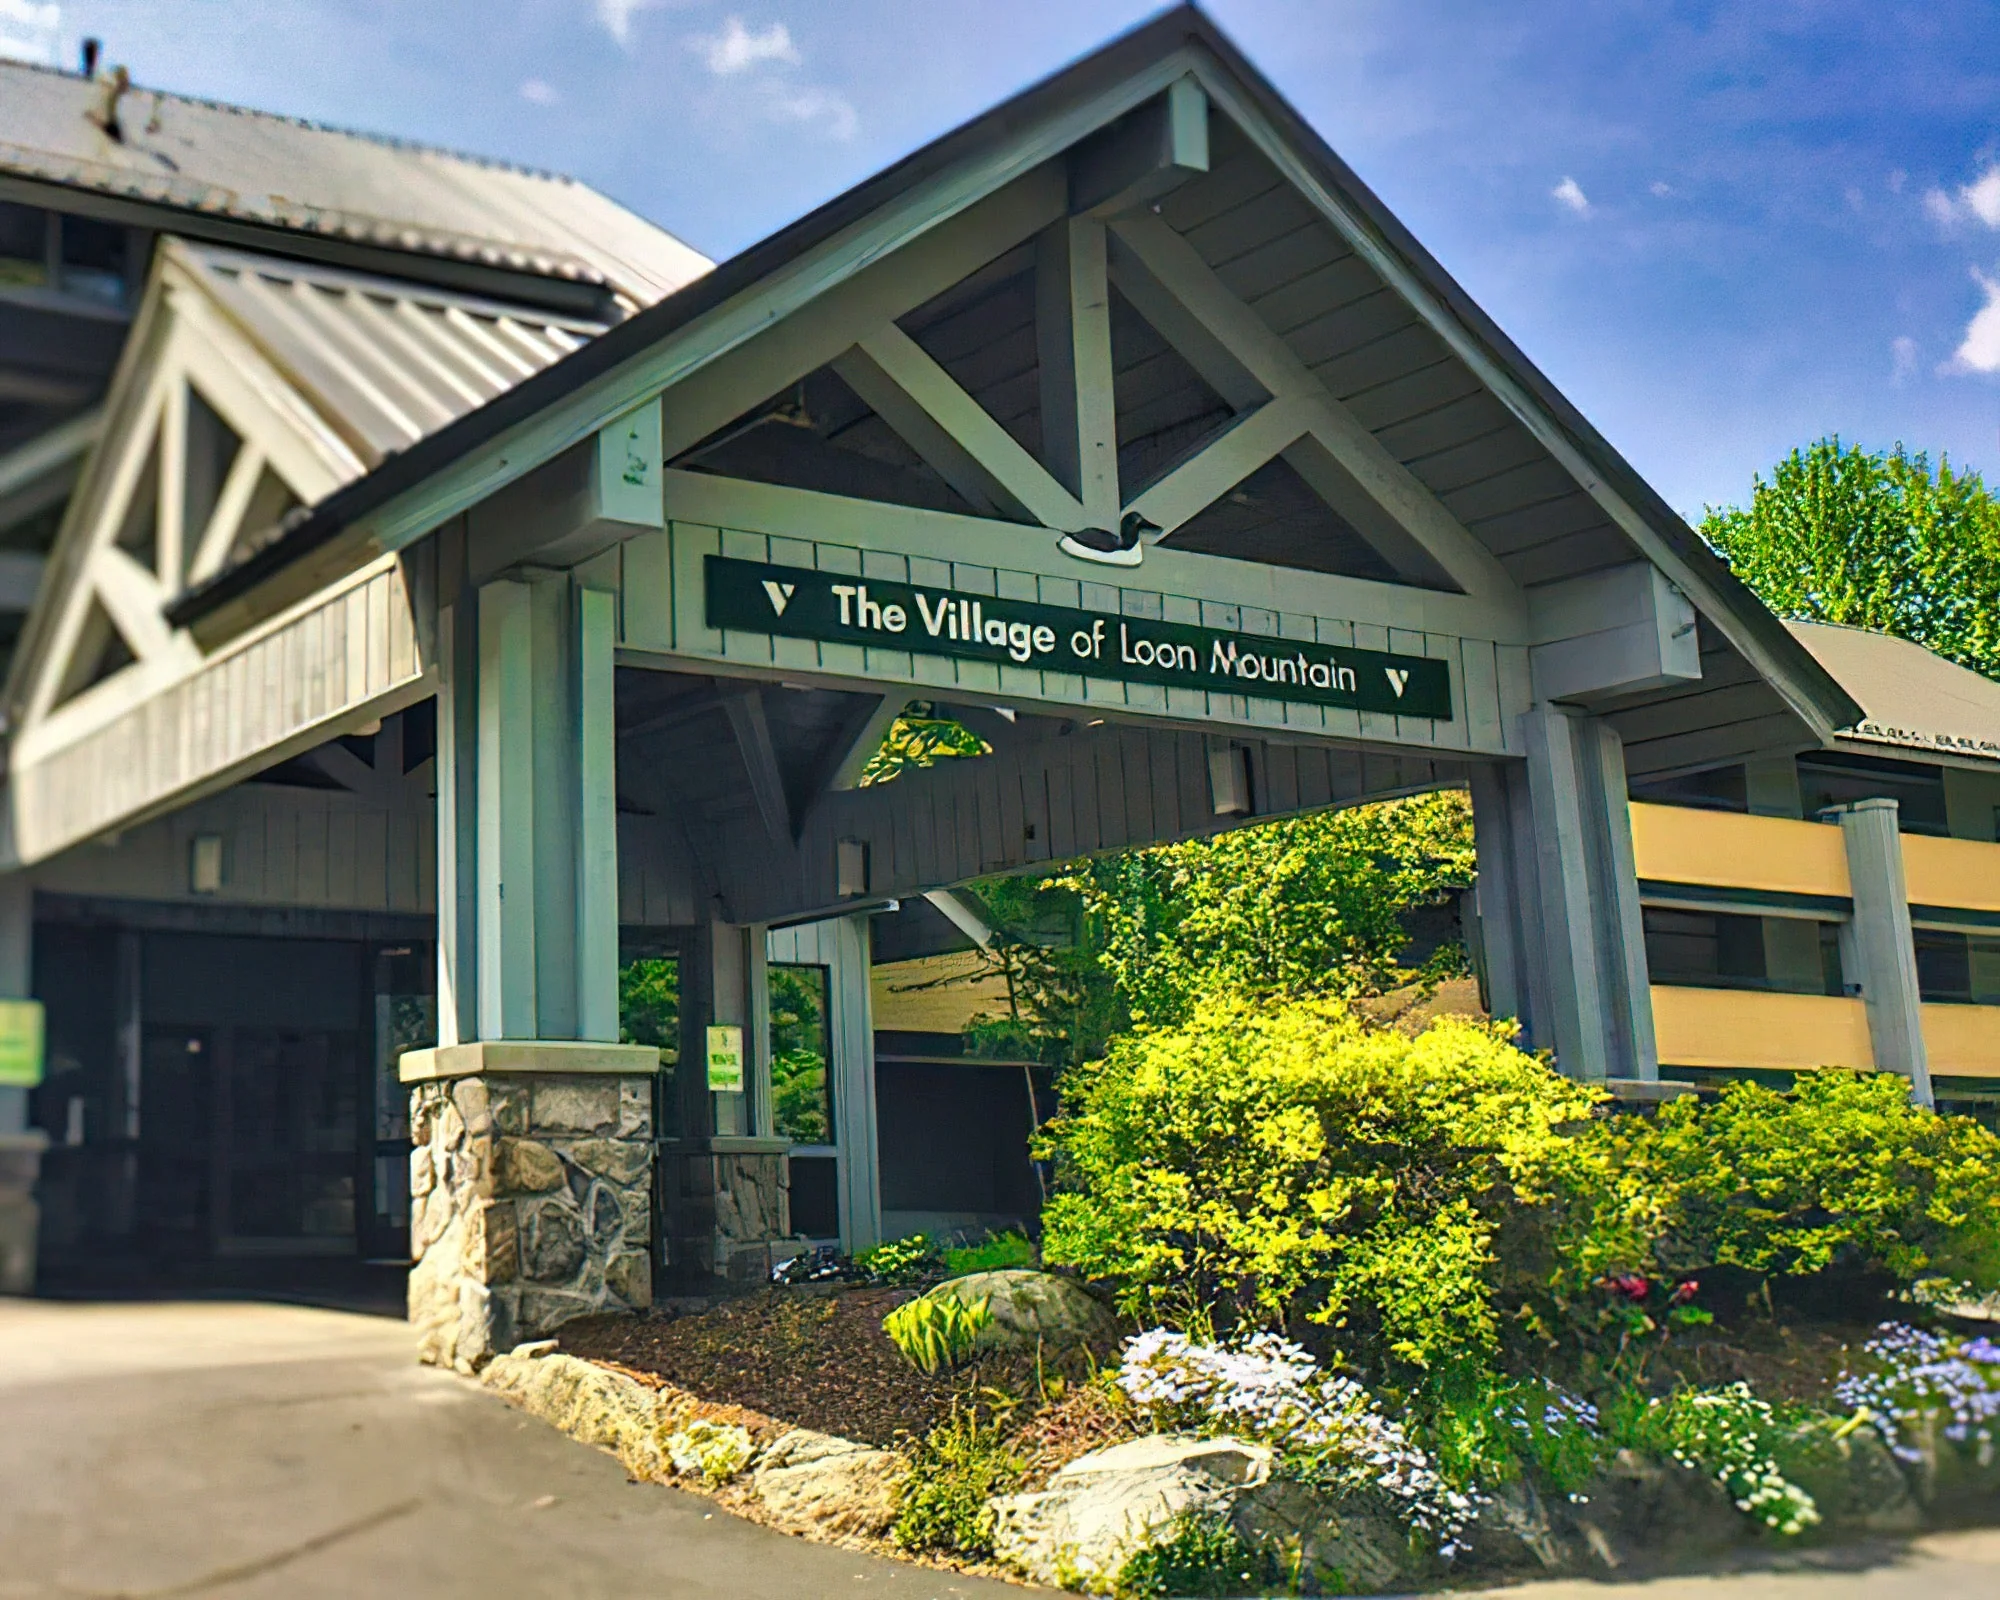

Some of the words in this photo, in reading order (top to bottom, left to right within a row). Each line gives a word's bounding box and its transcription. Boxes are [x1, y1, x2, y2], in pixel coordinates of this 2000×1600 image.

[831, 584, 907, 632] The
[914, 592, 1056, 662] Village
[1070, 619, 1105, 659] of
[1119, 622, 1197, 672] Loon
[1209, 639, 1357, 692] Mountain
